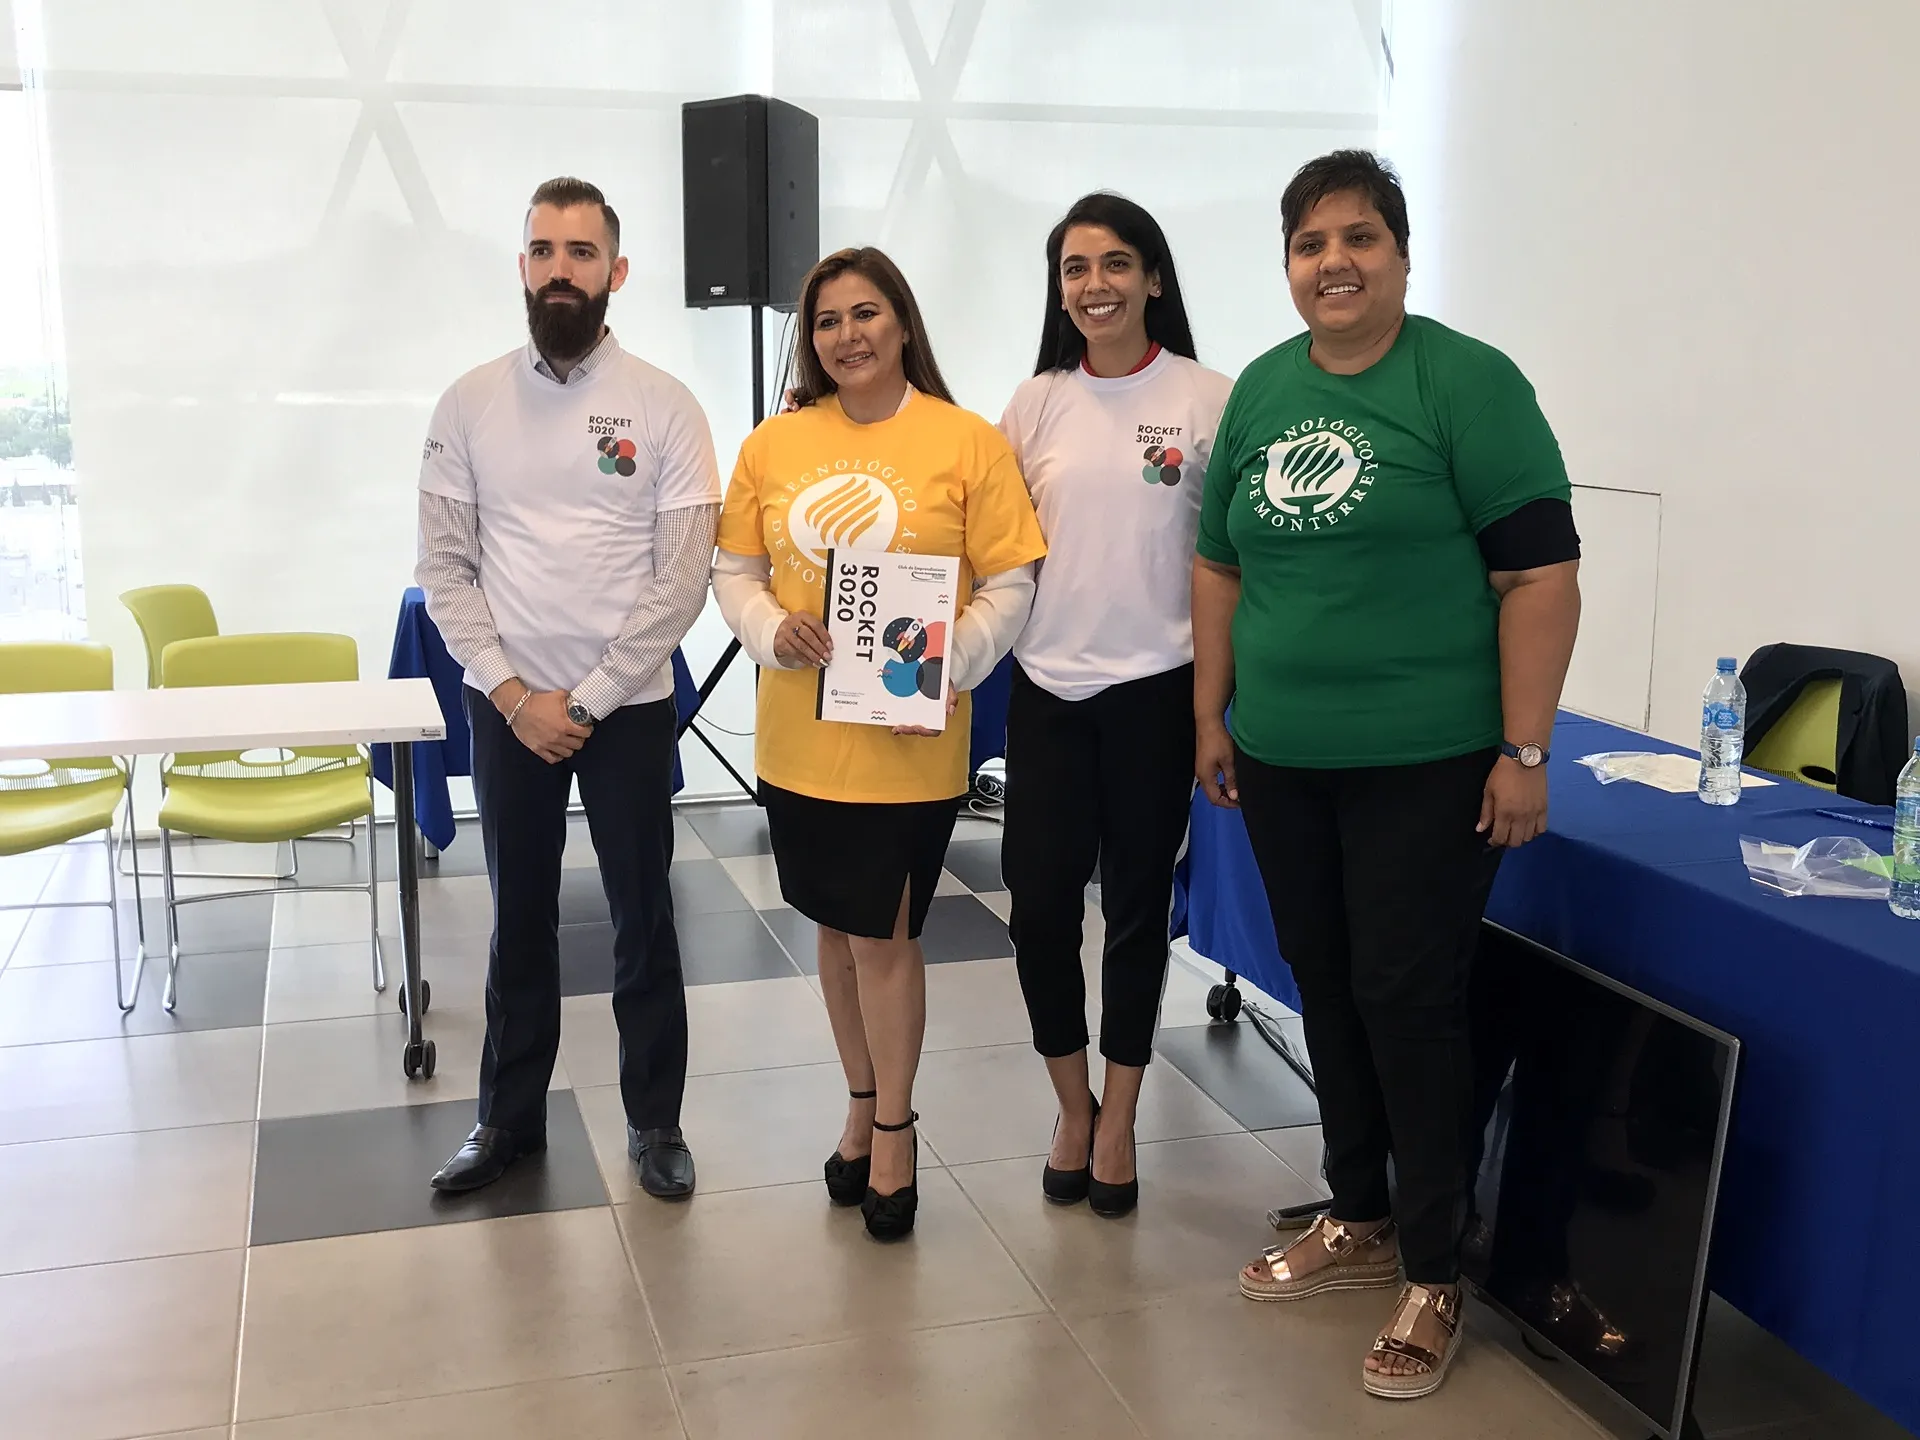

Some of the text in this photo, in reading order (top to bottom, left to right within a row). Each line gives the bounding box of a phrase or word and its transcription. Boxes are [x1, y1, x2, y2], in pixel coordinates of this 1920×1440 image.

[587, 425, 615, 435] 3020
[588, 415, 633, 428] ROCKET
[1137, 424, 1183, 436] ROCKET
[425, 438, 445, 454] CKET
[1135, 434, 1164, 444] 3020
[1256, 417, 1374, 461] NOLÓGICO
[777, 458, 918, 512] TECNOLÓGICO
[1249, 462, 1379, 532] DE MONTERREY
[771, 519, 787, 551] DE
[837, 563, 858, 622] 3020
[856, 565, 880, 663] ROCKET
